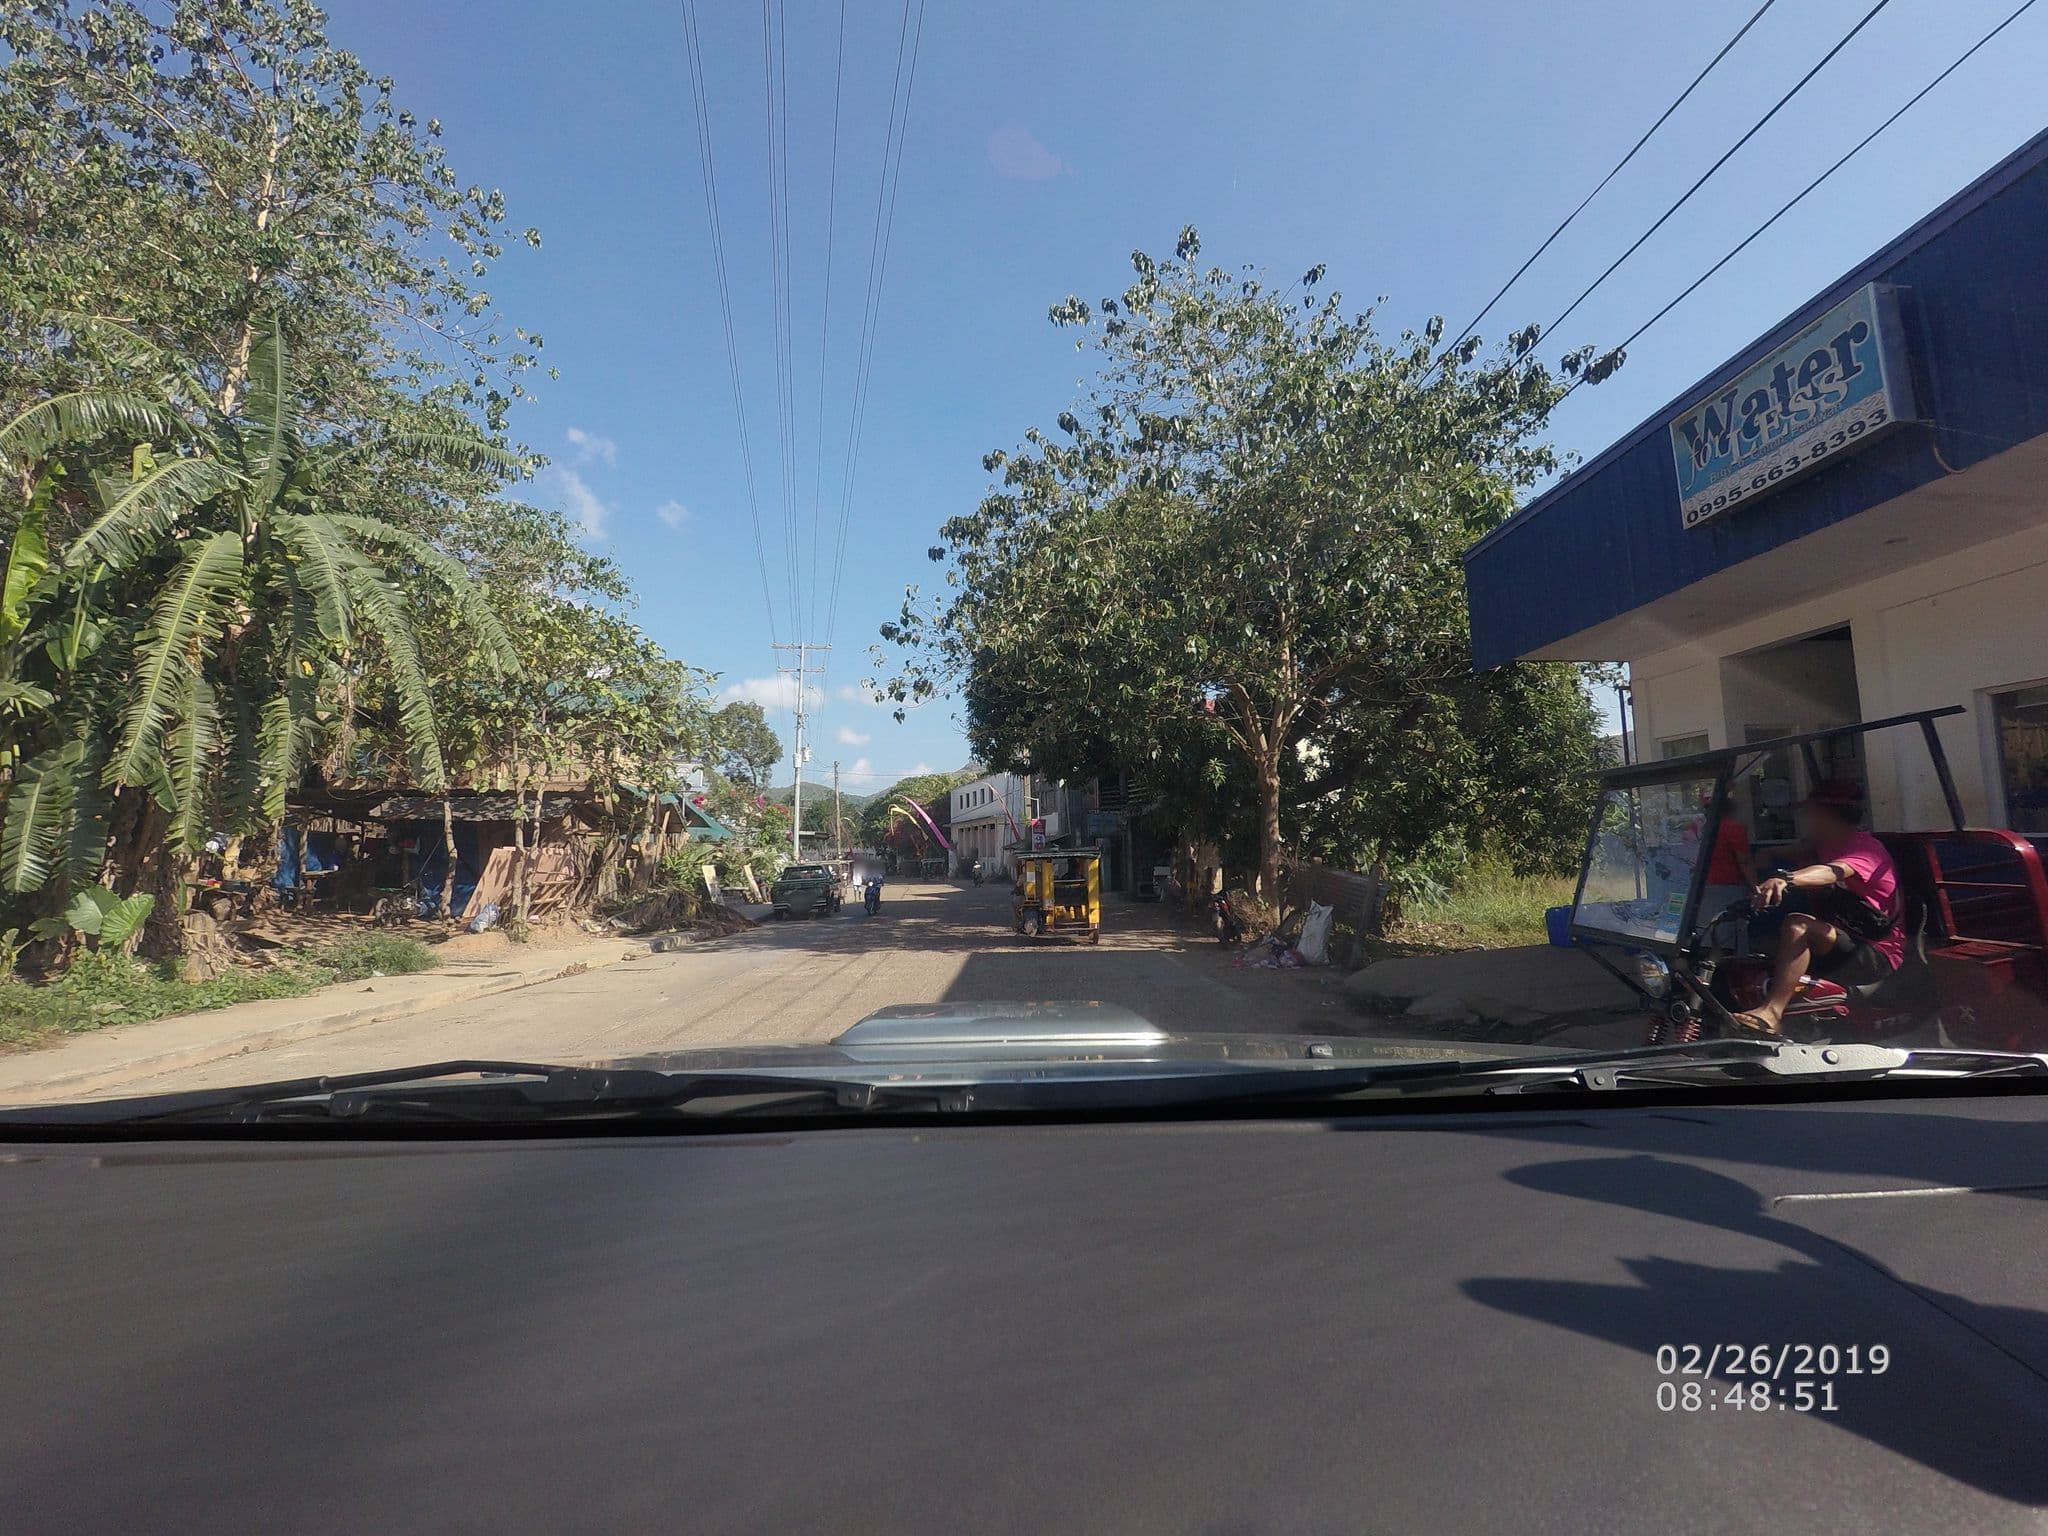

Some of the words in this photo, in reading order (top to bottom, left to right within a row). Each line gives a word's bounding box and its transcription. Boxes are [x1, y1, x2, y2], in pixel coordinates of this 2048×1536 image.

[1678, 319, 1870, 470] Water
[1684, 428, 1730, 491] for
[1729, 369, 1849, 466] LESS
[1686, 407, 1889, 525] 0995-663-8393
